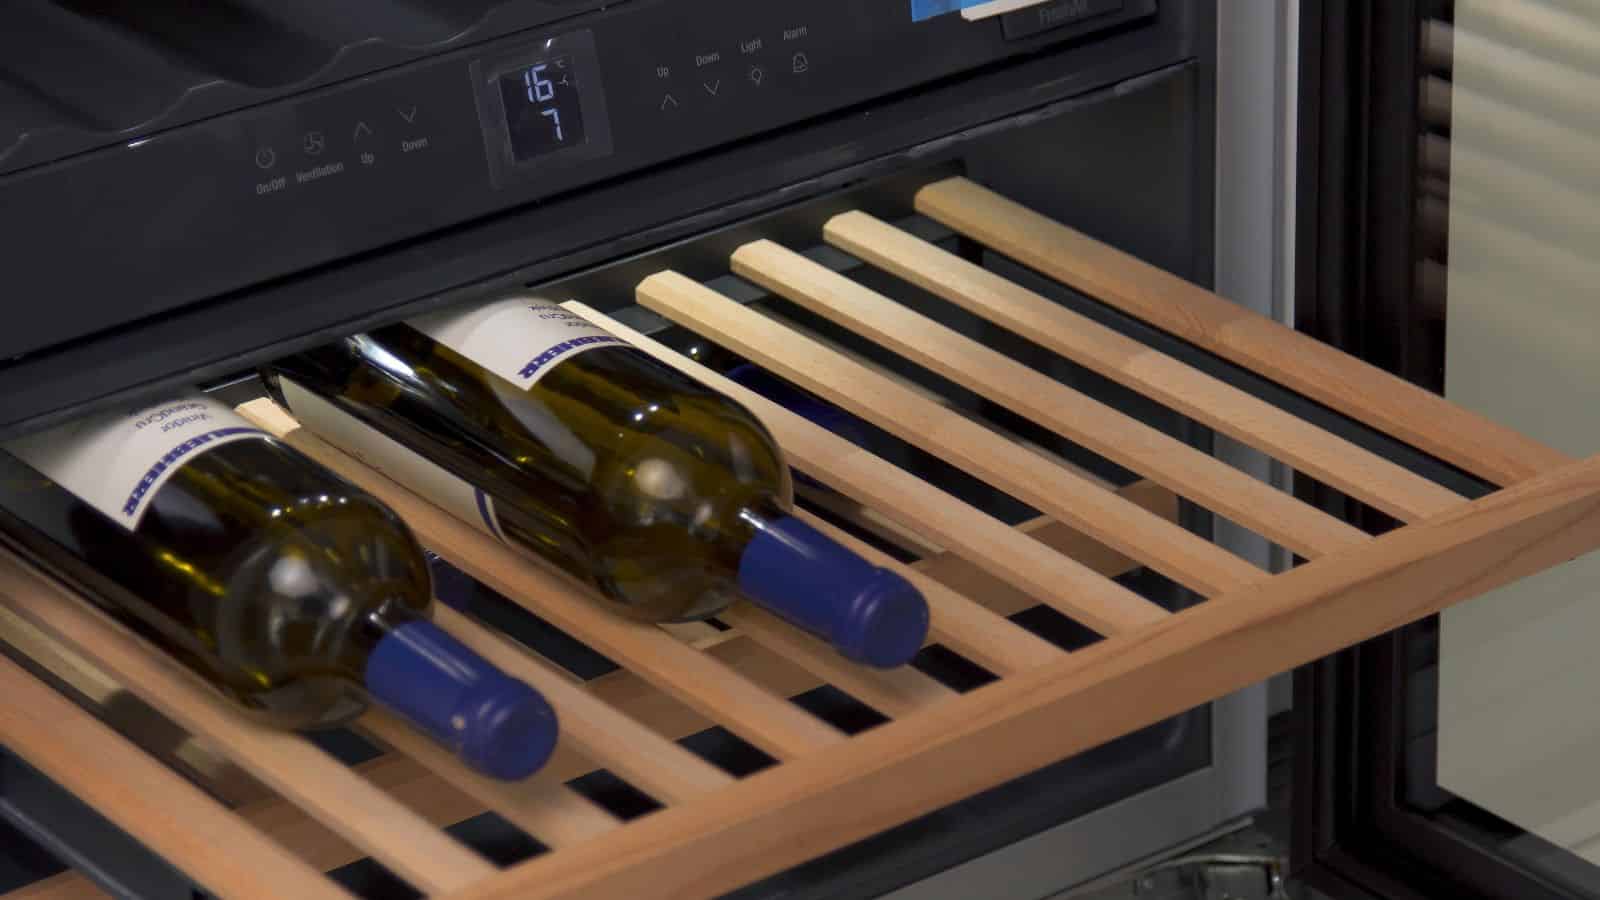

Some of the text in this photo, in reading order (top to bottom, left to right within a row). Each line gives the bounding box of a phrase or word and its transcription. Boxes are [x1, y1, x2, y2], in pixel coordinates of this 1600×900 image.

[784, 26, 807, 40] Alarm
[741, 39, 762, 53] Light
[697, 53, 719, 66] Down
[657, 66, 669, 78] Up
[524, 64, 554, 103] 16
[540, 107, 563, 141] 7
[402, 138, 428, 152] Down
[360, 152, 374, 165] Up
[296, 162, 344, 183] Ventilation
[256, 177, 286, 194] On/Off
